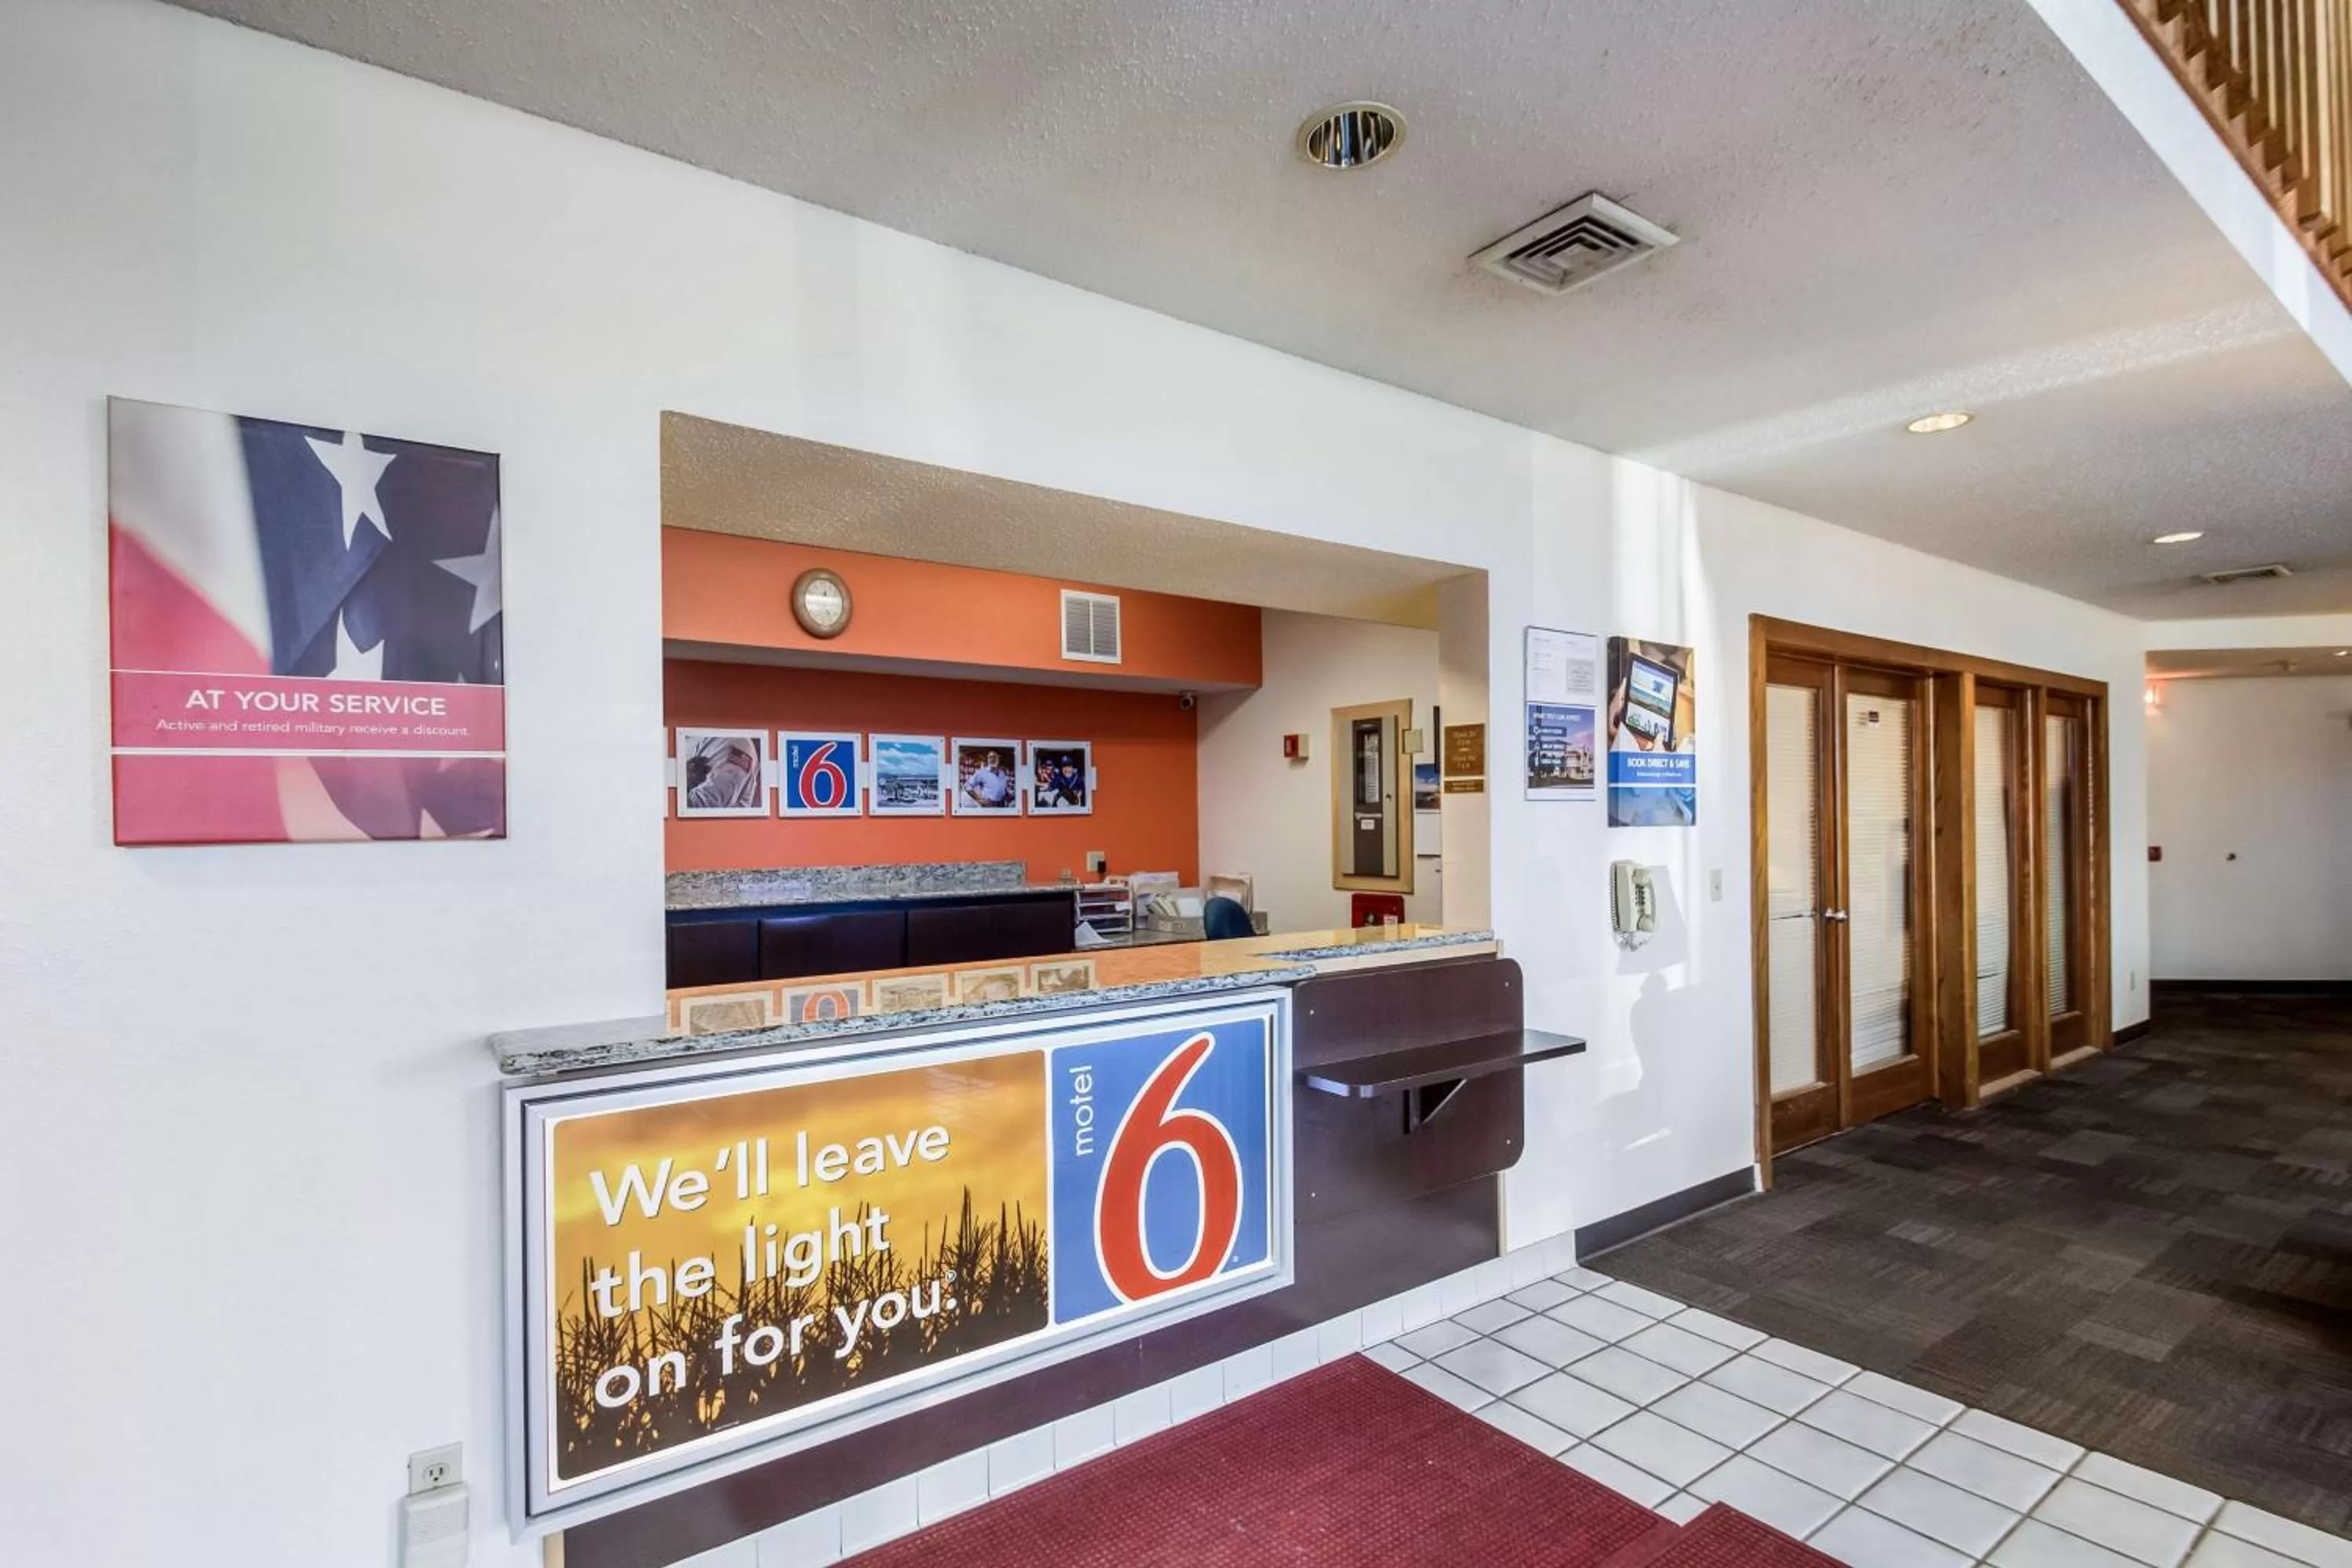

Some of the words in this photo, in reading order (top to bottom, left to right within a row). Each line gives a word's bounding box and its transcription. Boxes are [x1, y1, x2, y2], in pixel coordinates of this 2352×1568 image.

[155, 719, 204, 731] Active
[208, 719, 238, 732] and
[242, 720, 290, 733] retired
[295, 720, 345, 736] military
[350, 724, 398, 735] receive
[401, 726, 408, 735] a
[185, 689, 226, 710] AT
[234, 691, 320, 713] YOUR
[328, 693, 446, 716] SERVICE
[798, 742, 847, 809] 6
[590, 1138, 769, 1228] We'll
[797, 1124, 950, 1188] leave
[1069, 1064, 1094, 1157] motel
[1094, 1031, 1244, 1305] 6
[591, 1250, 716, 1319] the
[744, 1206, 891, 1288] light
[594, 1349, 687, 1409] on
[714, 1313, 814, 1376] for
